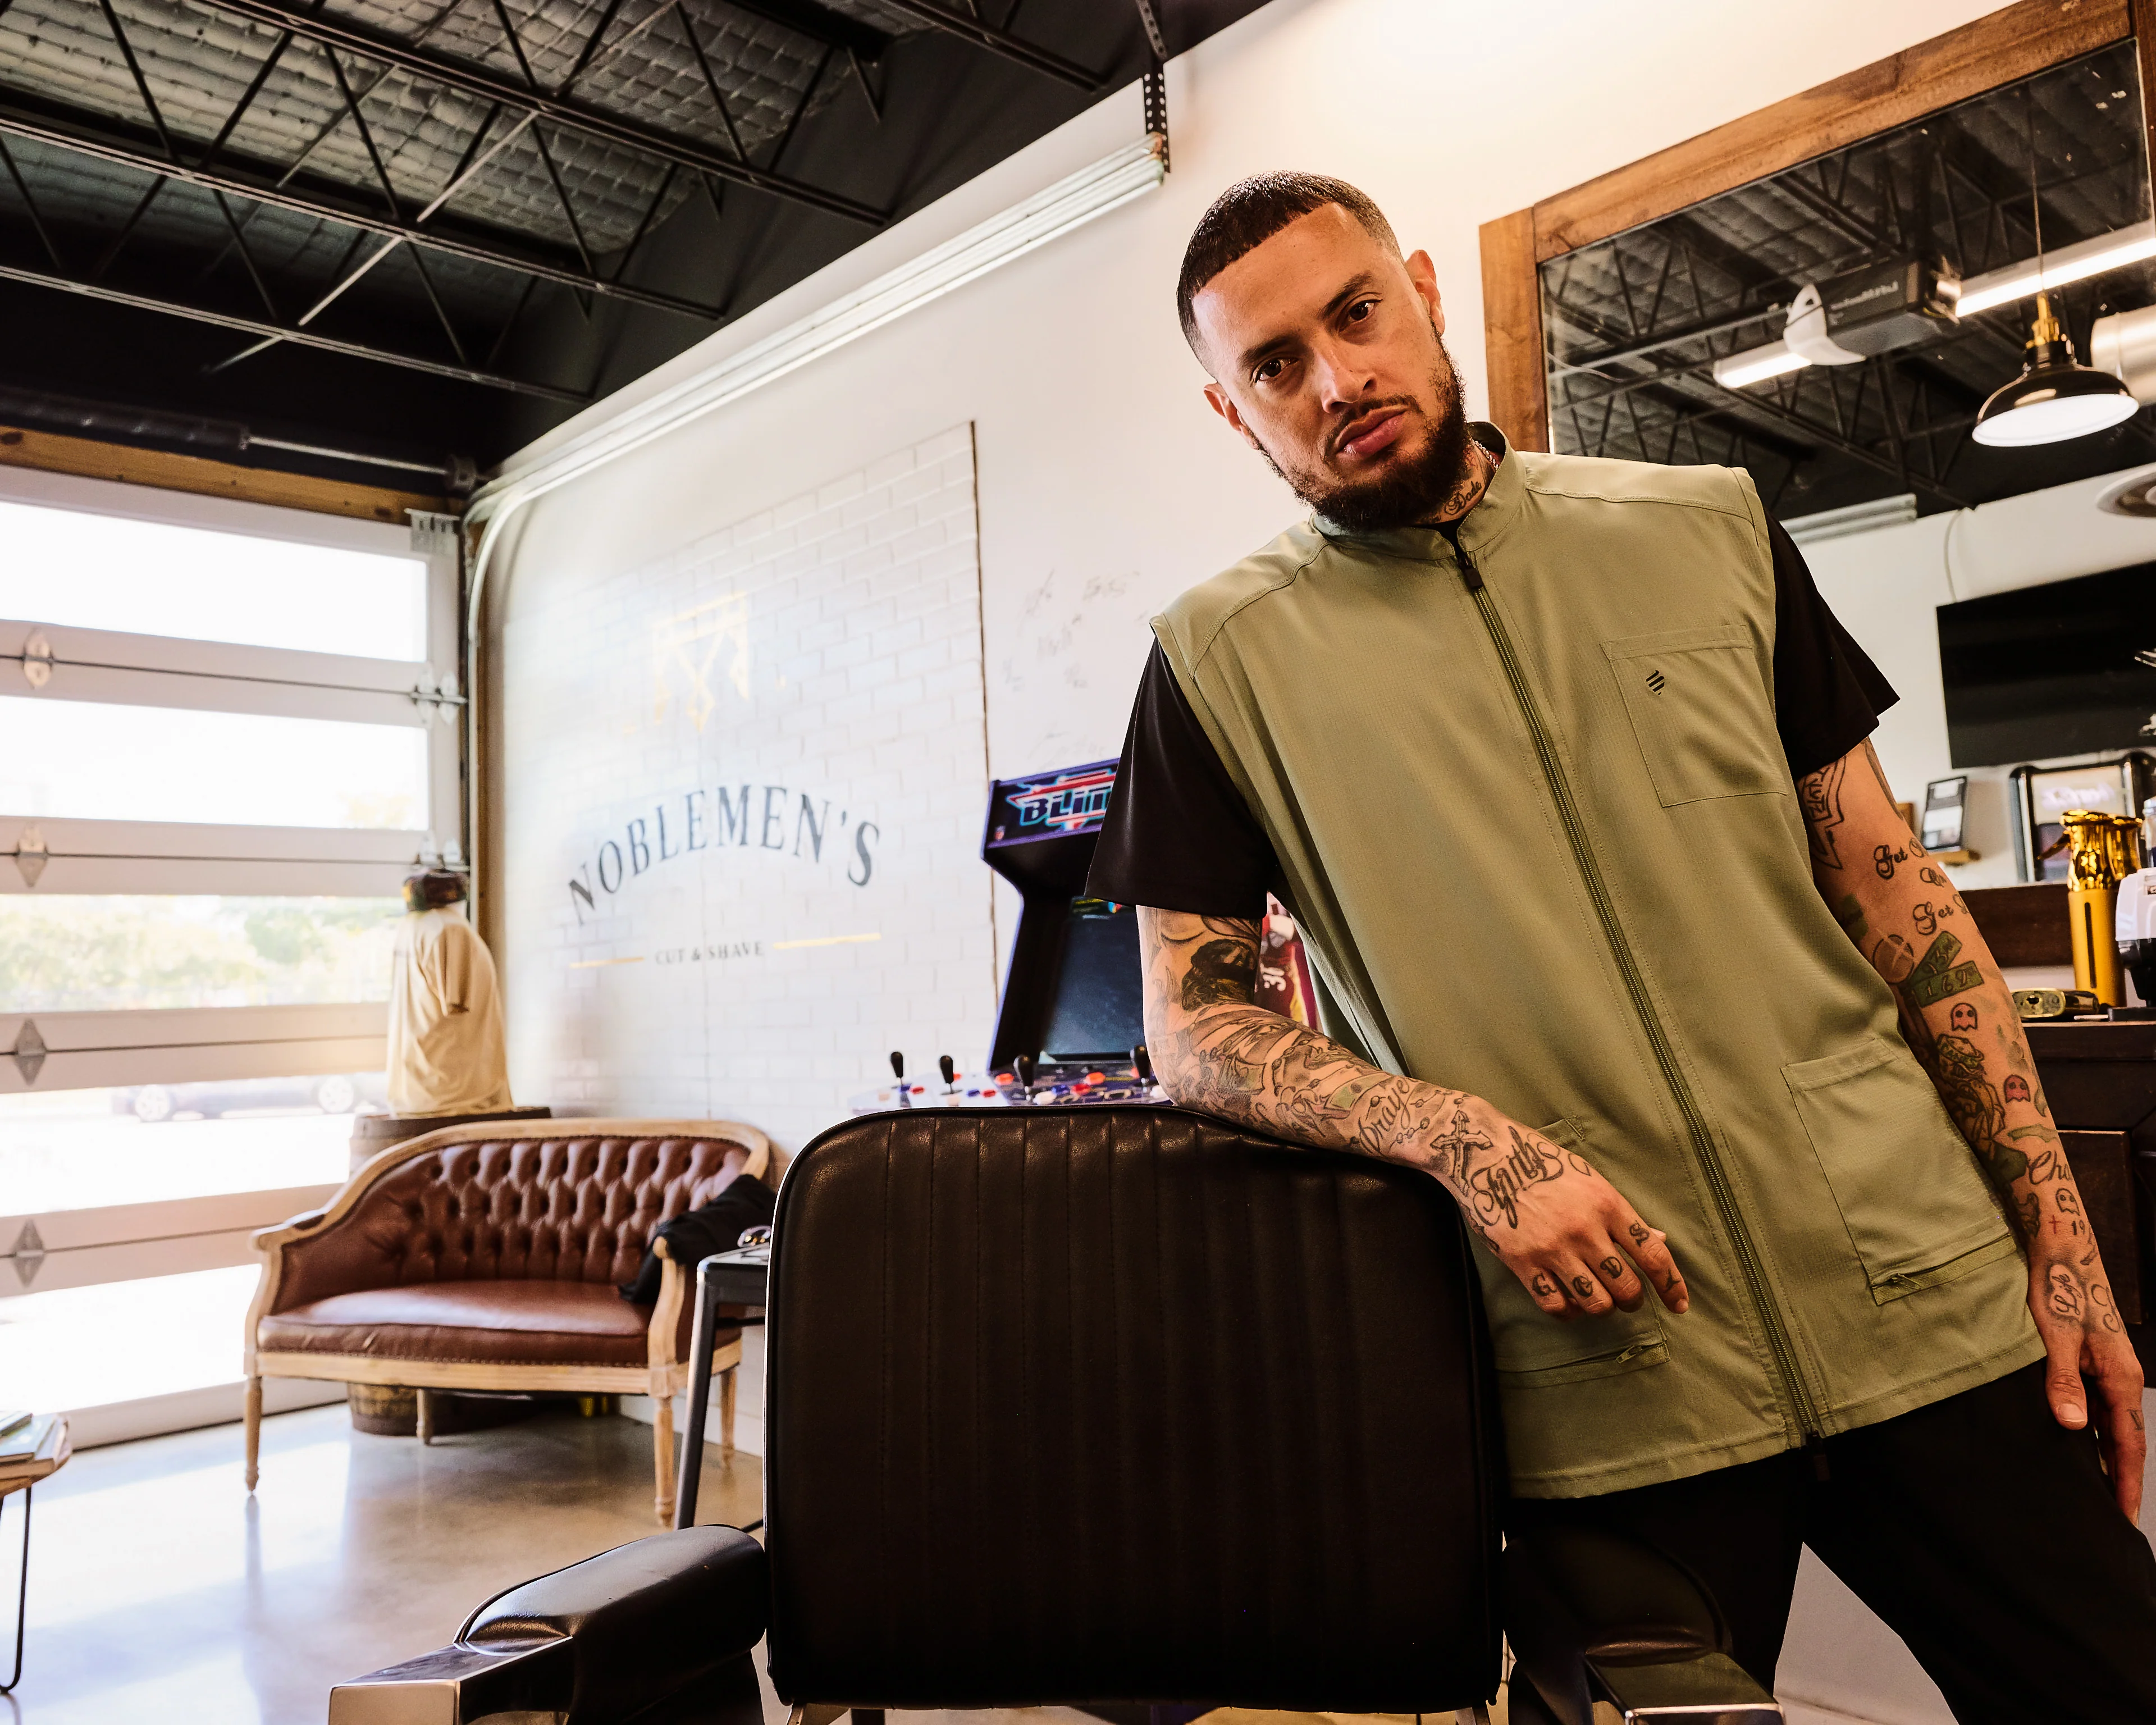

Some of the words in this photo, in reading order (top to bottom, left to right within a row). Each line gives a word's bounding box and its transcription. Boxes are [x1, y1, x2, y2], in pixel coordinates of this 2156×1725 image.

[569, 784, 880, 927] NOBLEMEN'S
[655, 947, 686, 965] CUT
[691, 946, 701, 961] &
[707, 940, 765, 961] SHAVE
